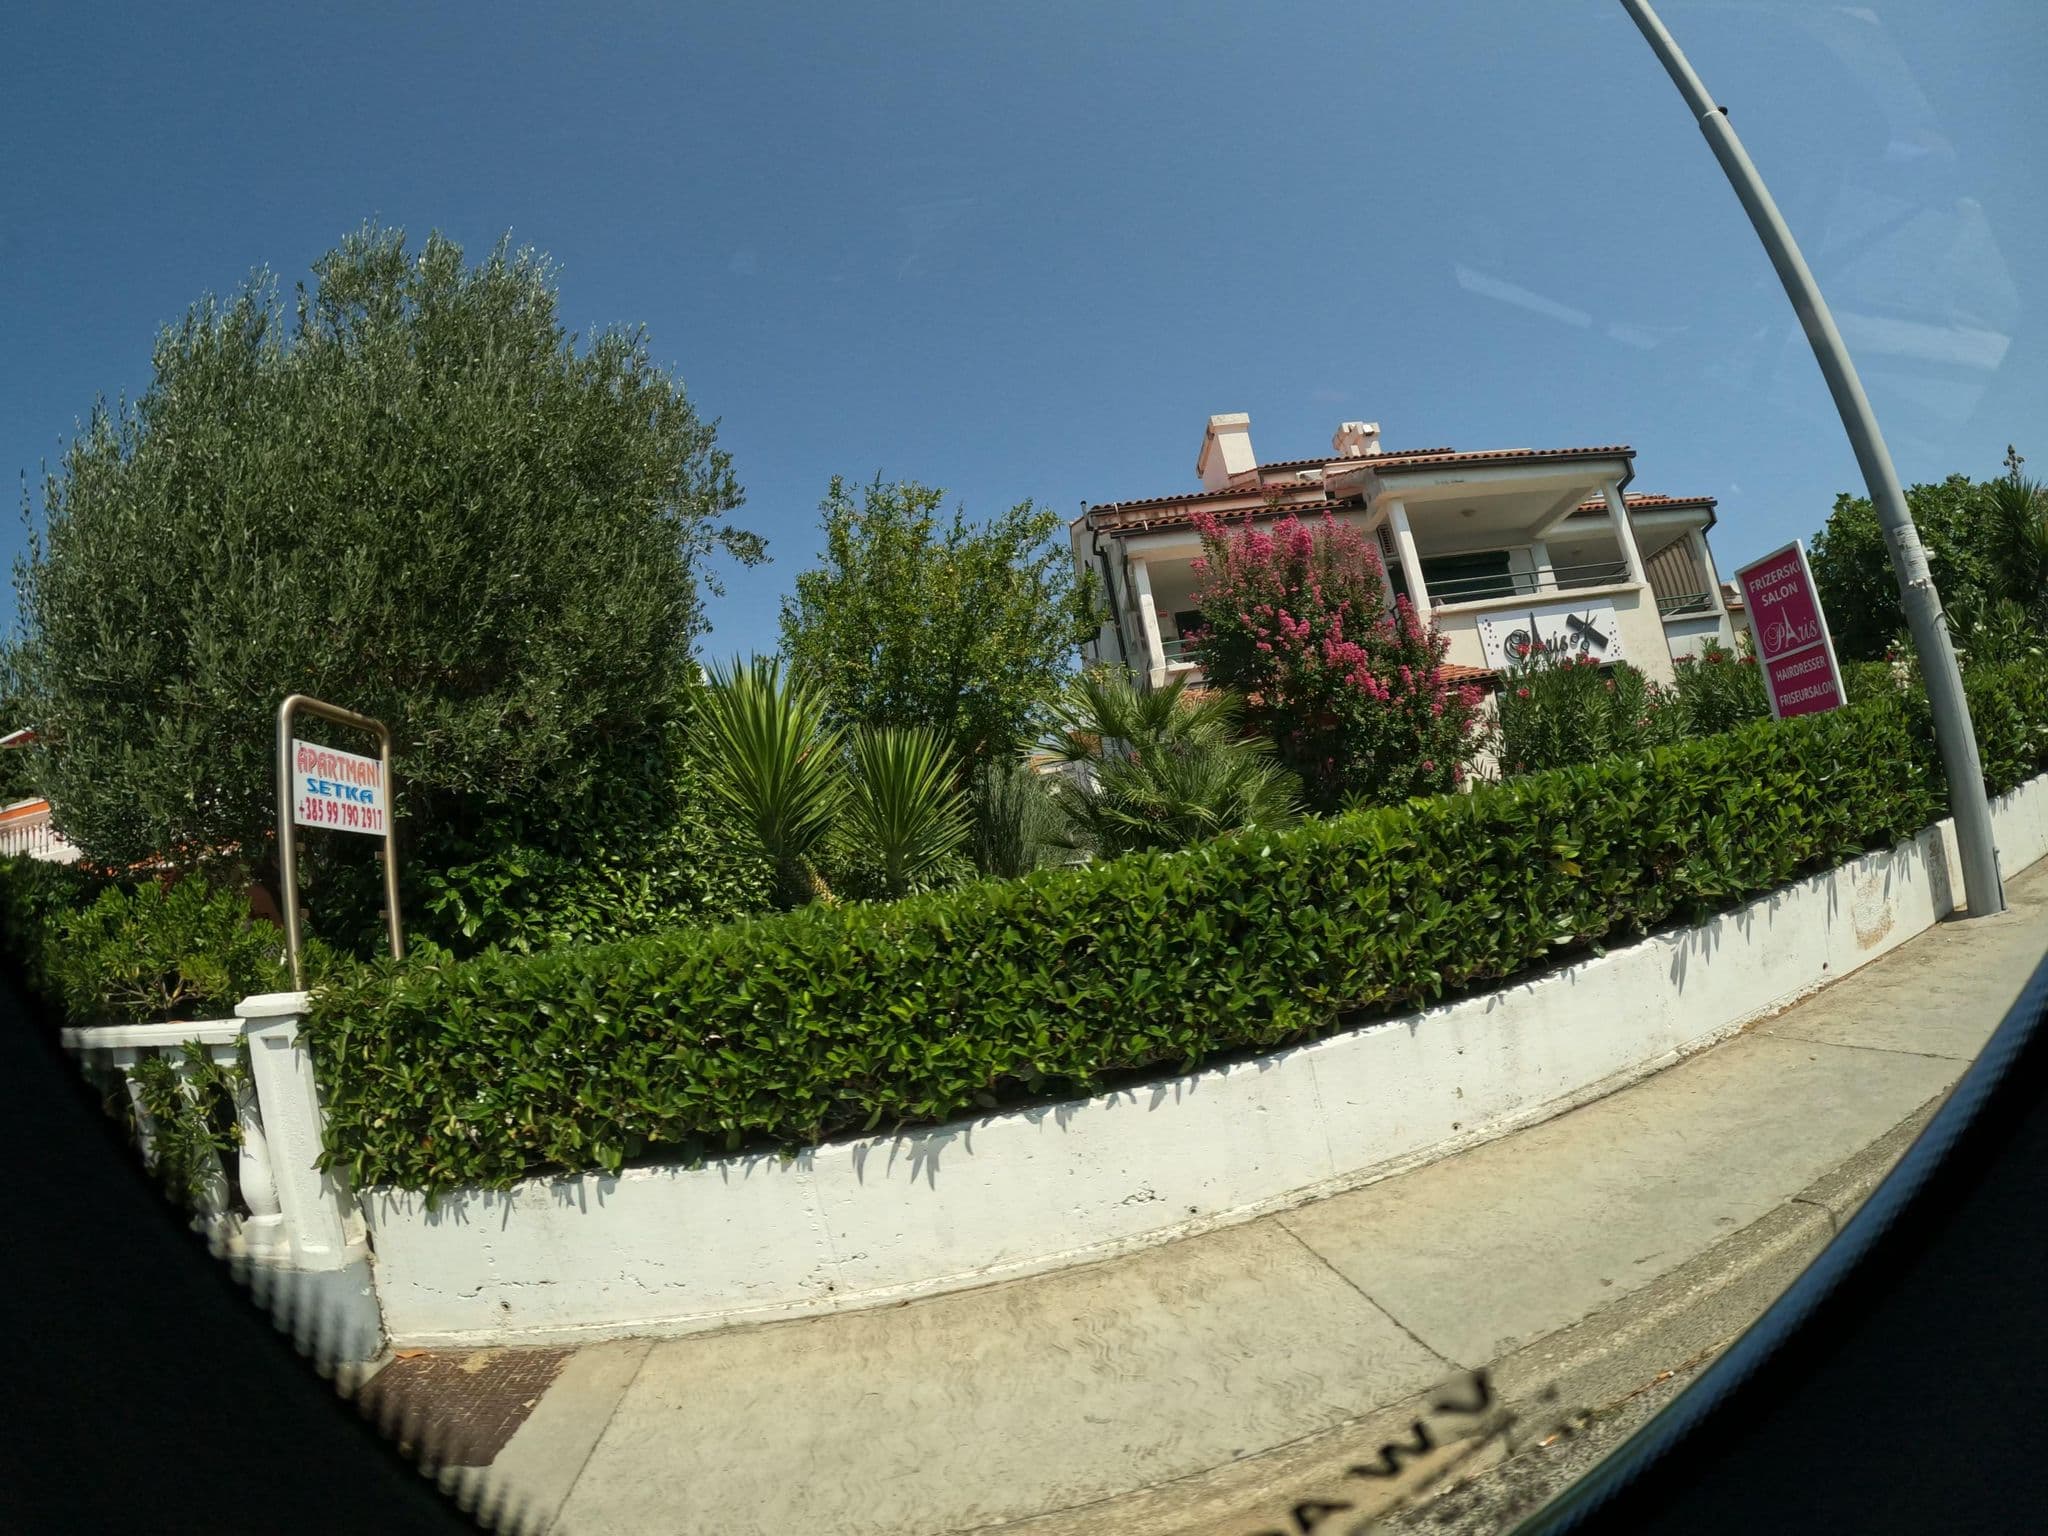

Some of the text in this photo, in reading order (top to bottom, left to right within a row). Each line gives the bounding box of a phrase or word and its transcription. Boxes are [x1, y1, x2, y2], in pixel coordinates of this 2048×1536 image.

[1749, 559, 1801, 594] FRIZERSKI
[1761, 582, 1799, 607] SALON
[1775, 655, 1827, 682] HAIRDRESSER
[1779, 679, 1836, 707] FRISEURSALON
[297, 746, 380, 788] APARTMANI
[306, 778, 374, 804] SETKA
[299, 797, 323, 821] +385
[326, 801, 339, 824] 99
[341, 803, 359, 827] 790
